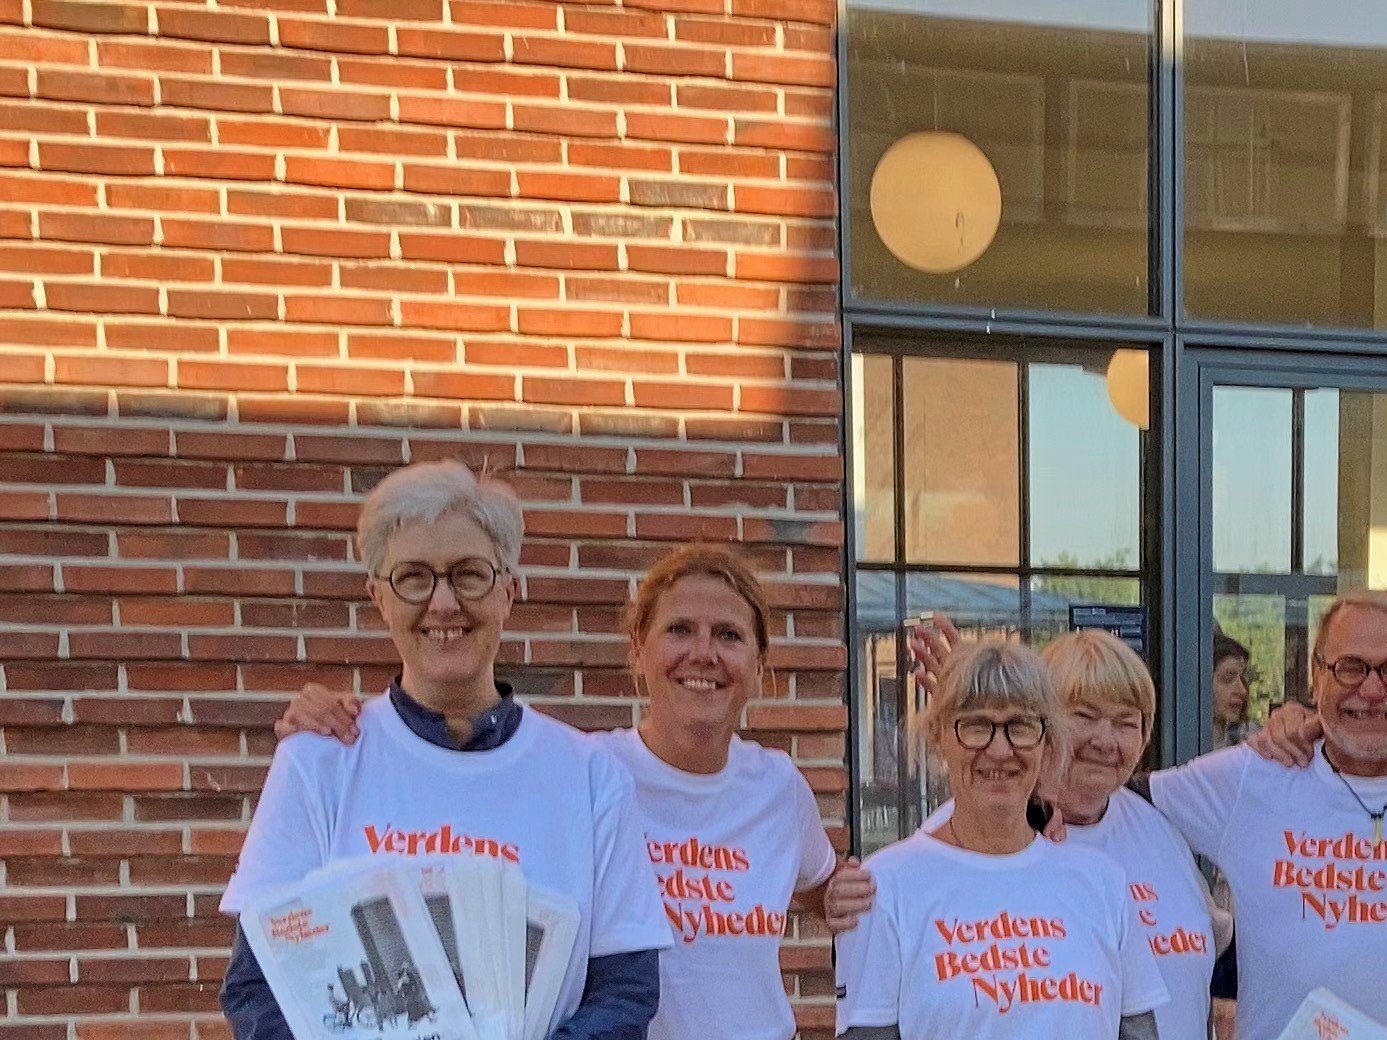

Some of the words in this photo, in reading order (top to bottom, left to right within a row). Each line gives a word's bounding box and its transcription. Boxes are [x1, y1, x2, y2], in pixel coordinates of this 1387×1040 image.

[364, 823, 520, 863] Verdens
[644, 832, 750, 871] erdens
[657, 869, 736, 901] dste
[1273, 859, 1386, 891] Bedste
[934, 910, 1067, 945] Verdens
[934, 942, 1051, 982] Bedste
[972, 971, 1103, 1015] Nyheder
